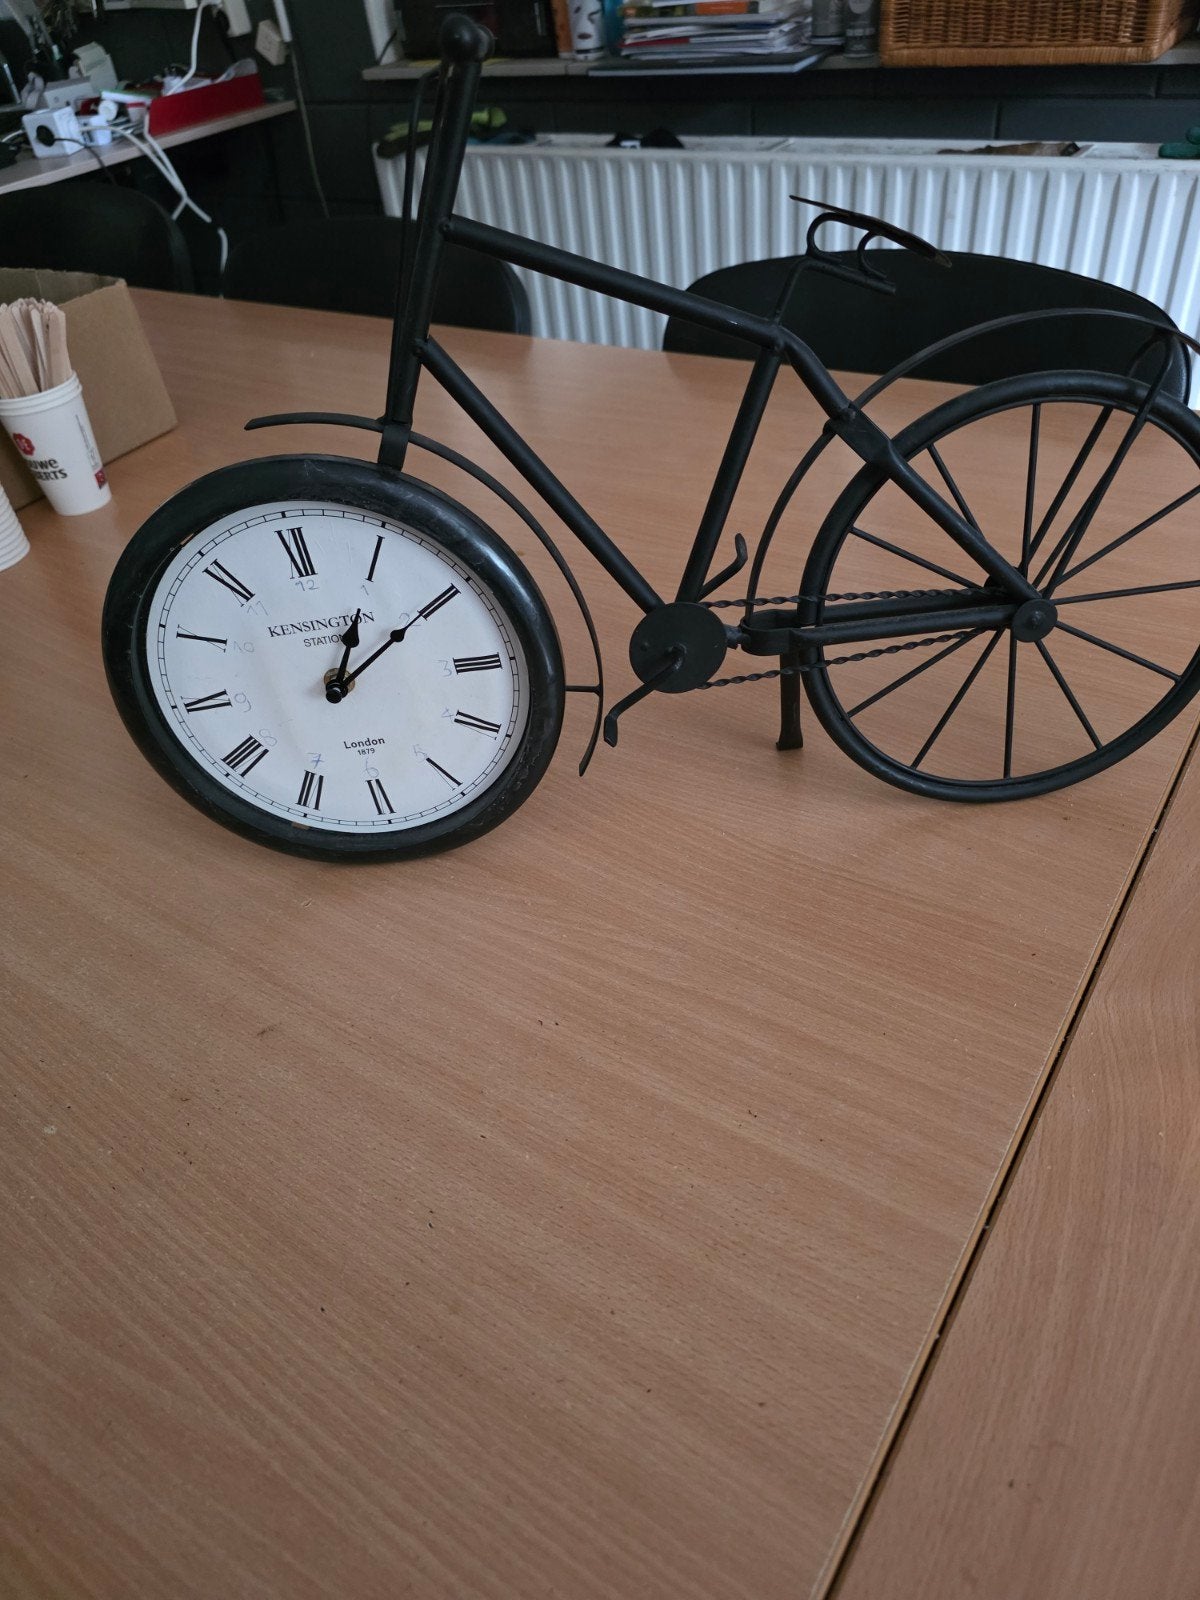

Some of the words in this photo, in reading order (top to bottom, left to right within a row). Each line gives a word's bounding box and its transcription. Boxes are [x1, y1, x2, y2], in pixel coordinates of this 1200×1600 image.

[274, 526, 319, 580] XII
[202, 558, 256, 608] XI
[294, 579, 320, 592] 12
[267, 611, 376, 638] KENSINGTON
[175, 623, 228, 653] X
[452, 651, 503, 676] III
[343, 737, 386, 750] London
[357, 747, 376, 756] 1879
